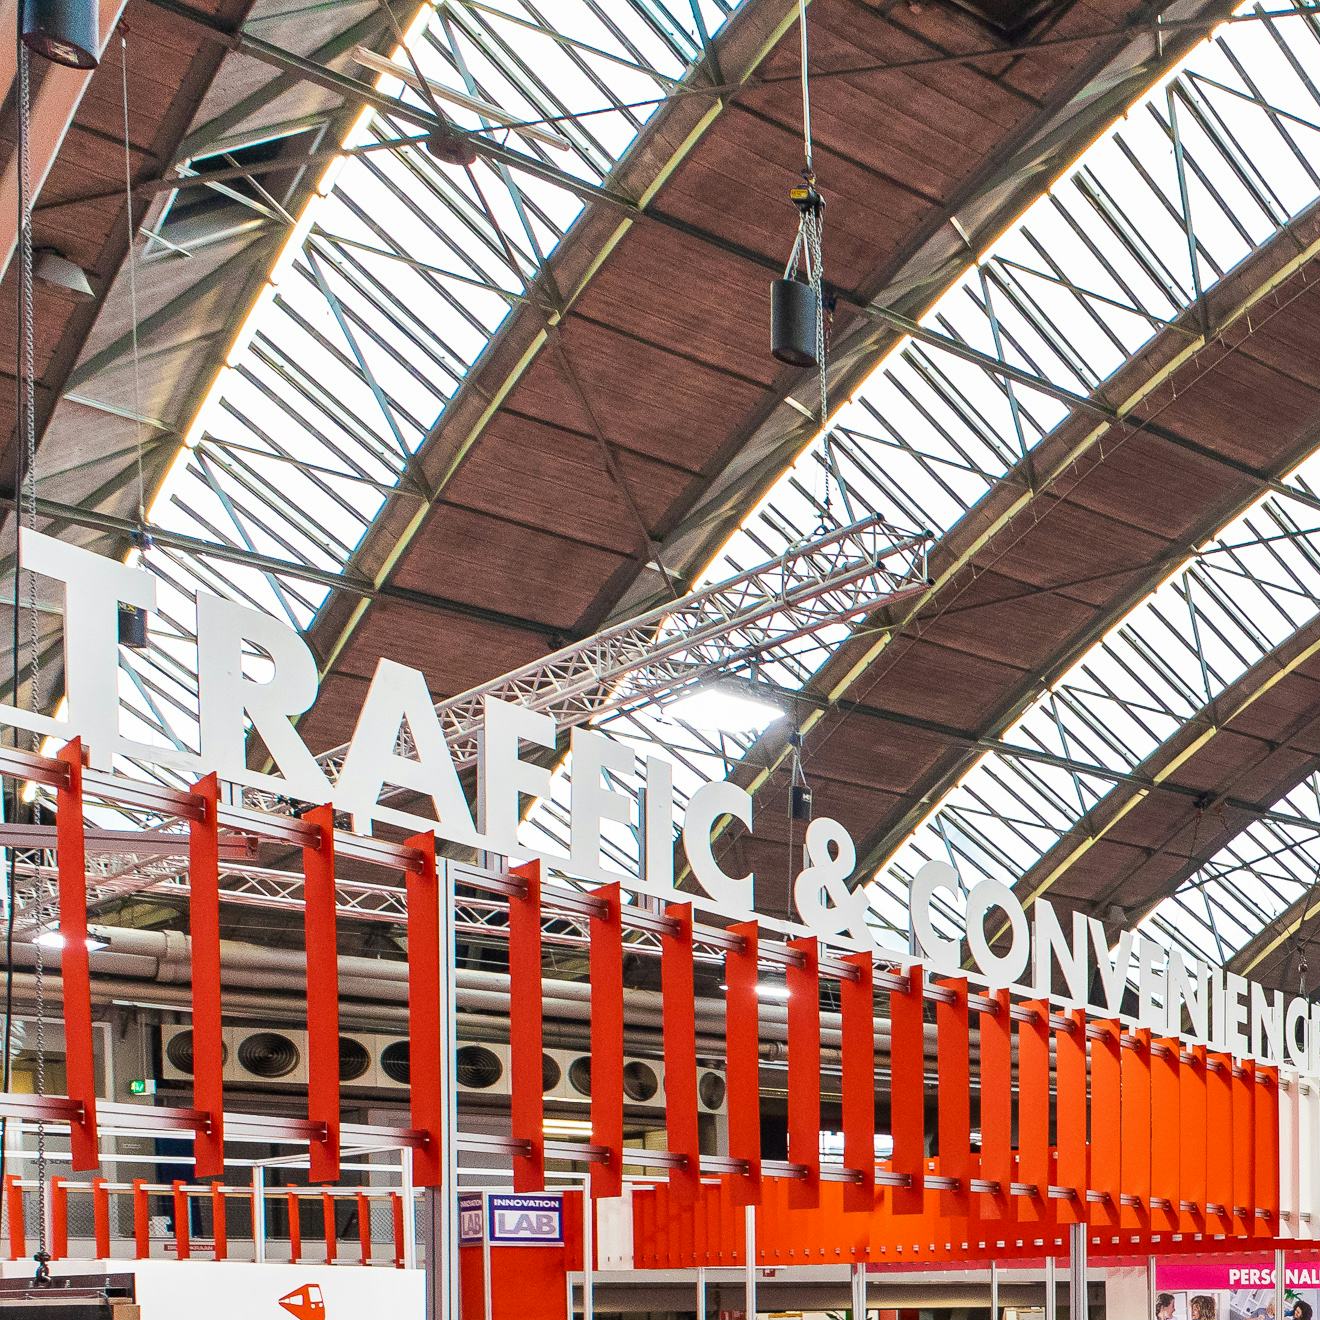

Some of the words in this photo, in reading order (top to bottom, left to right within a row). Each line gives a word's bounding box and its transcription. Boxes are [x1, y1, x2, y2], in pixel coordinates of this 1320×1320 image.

[20, 526, 755, 911] TRAFFIC
[795, 817, 875, 949] &
[494, 1198, 559, 1208] INNOVATION
[498, 1212, 556, 1235] LAB
